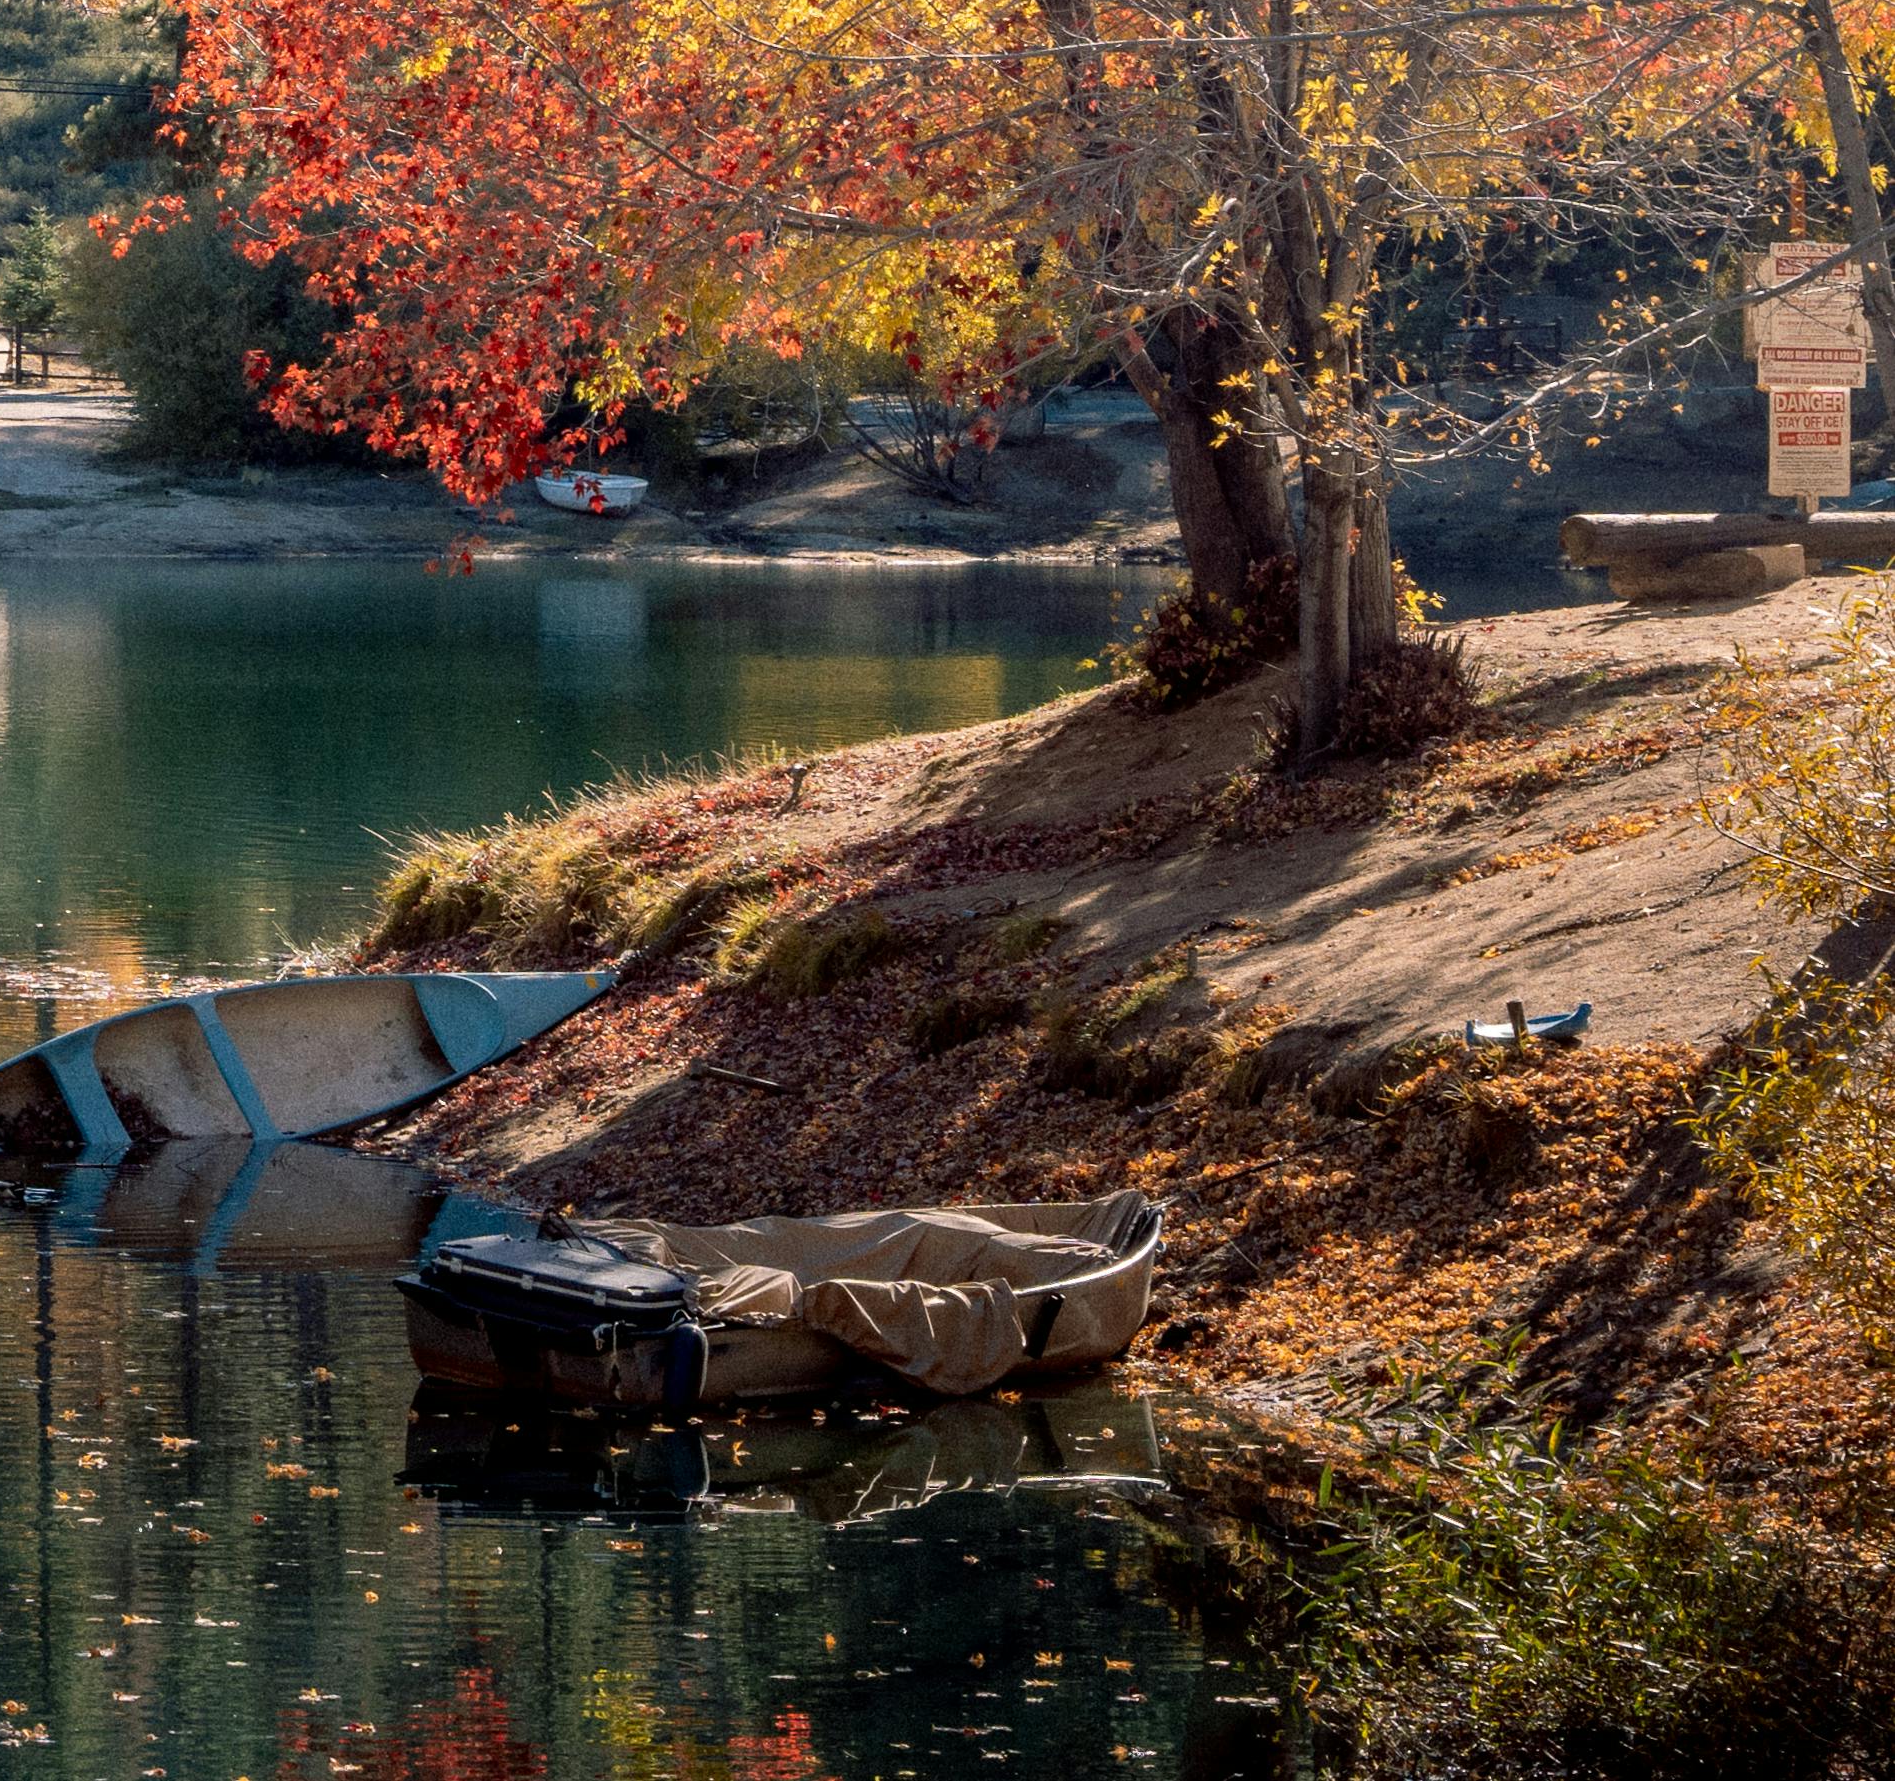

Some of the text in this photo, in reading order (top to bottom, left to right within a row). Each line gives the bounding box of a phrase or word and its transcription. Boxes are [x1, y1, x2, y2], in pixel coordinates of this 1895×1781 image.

[1777, 350, 1794, 359] DOGS
[1795, 350, 1812, 360] MUST
[1840, 351, 1859, 361] LEASH
[1775, 393, 1844, 412] DANGER
[1776, 416, 1800, 429] STAY
[1804, 416, 1821, 429] OFF
